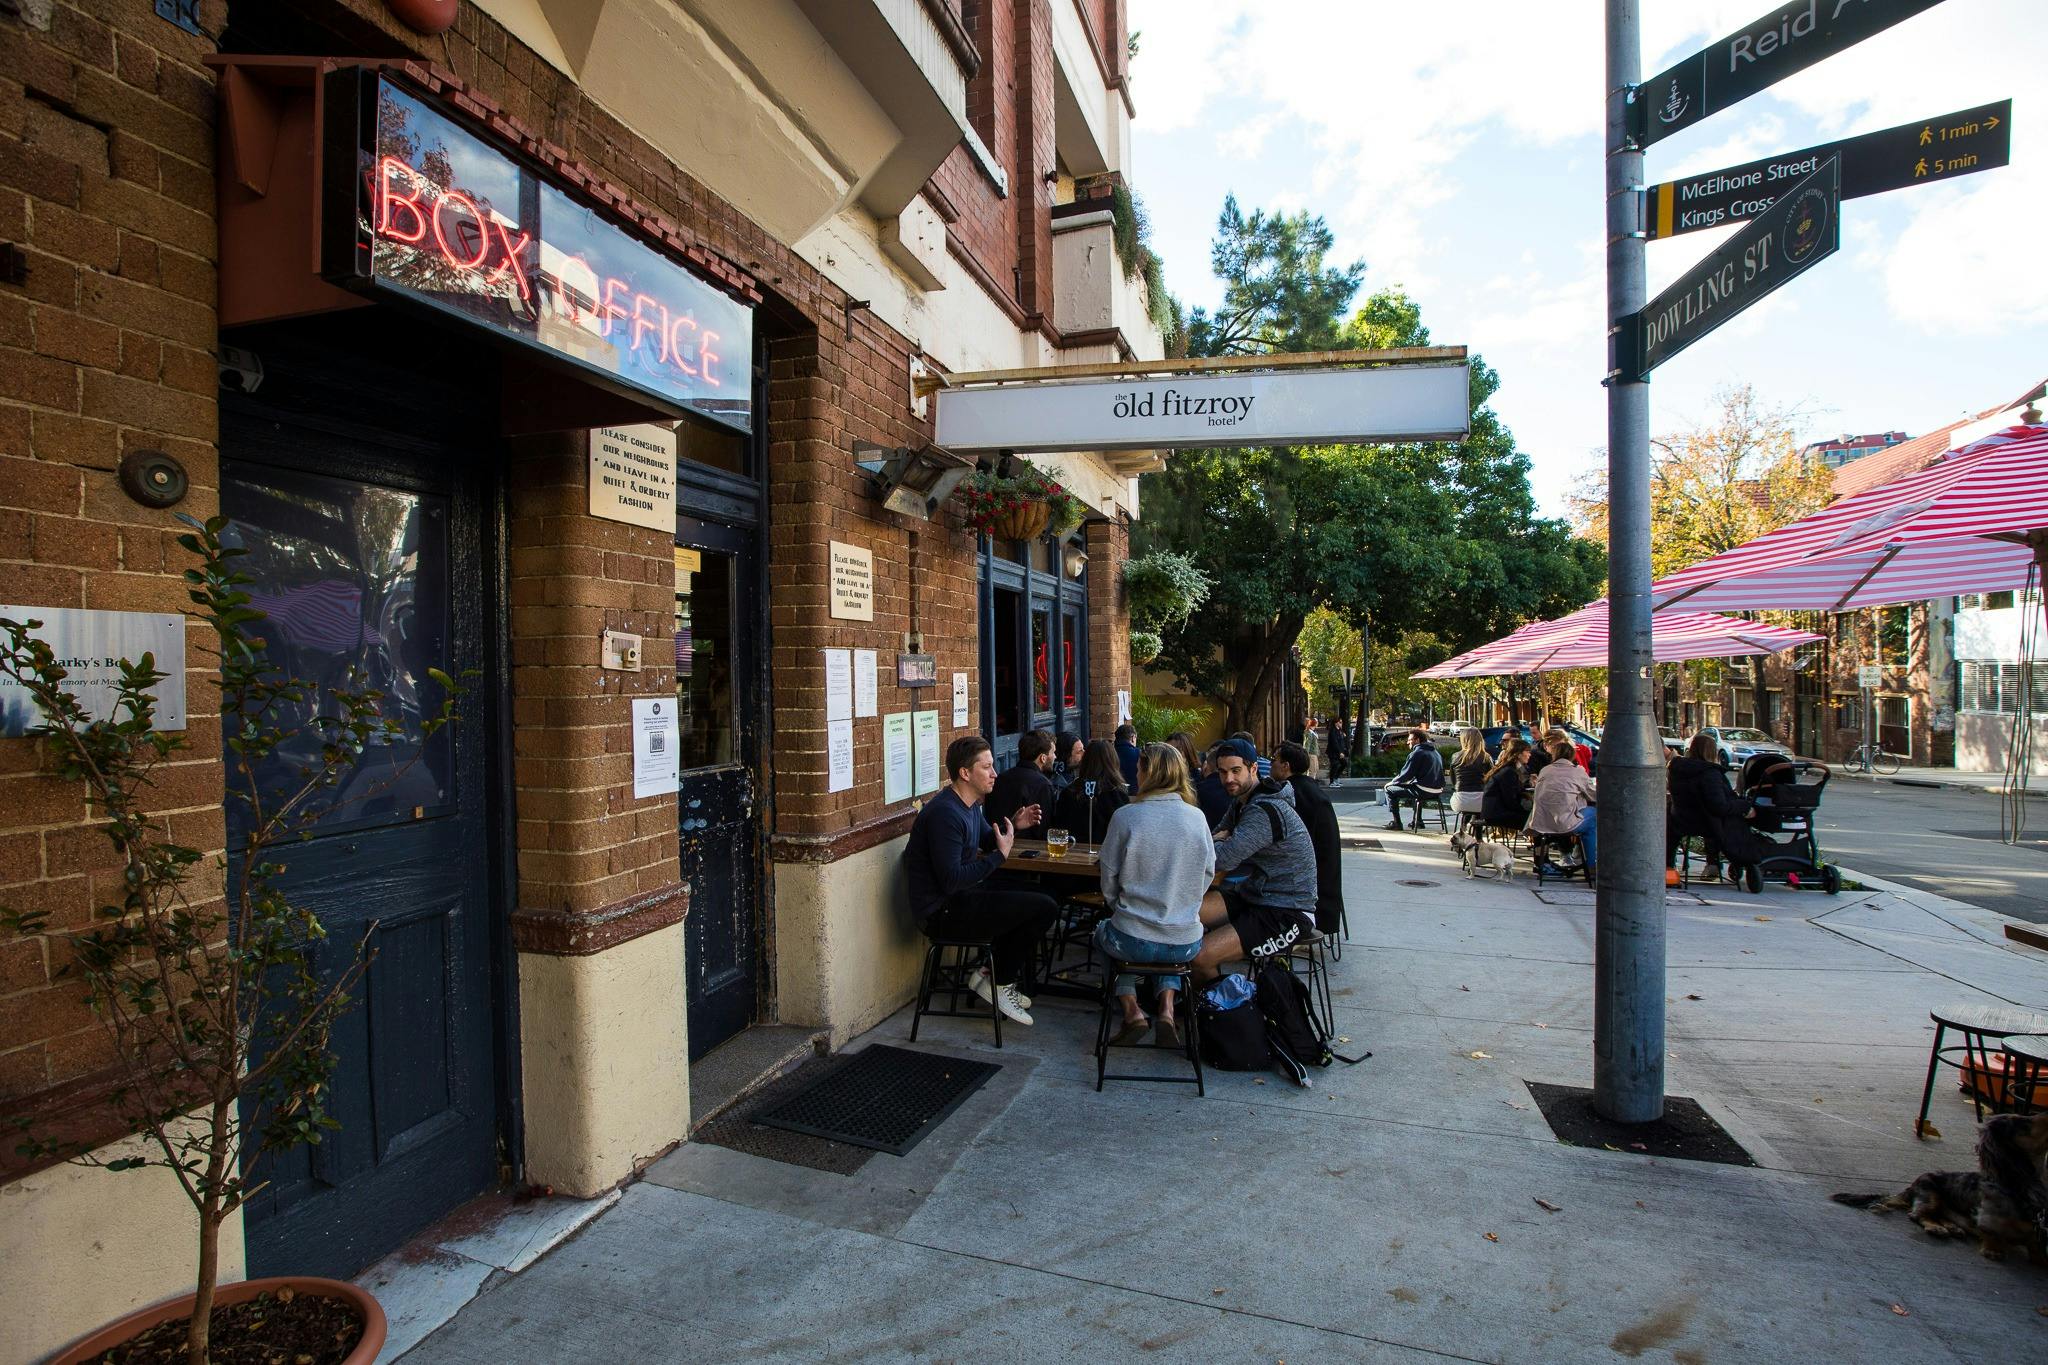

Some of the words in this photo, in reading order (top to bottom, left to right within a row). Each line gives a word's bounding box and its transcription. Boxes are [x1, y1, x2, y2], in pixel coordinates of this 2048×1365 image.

[1730, 0, 1816, 73] Reid
[1939, 127, 1946, 141] 1
[1949, 122, 1979, 139] min
[1934, 159, 1944, 174] 5
[1948, 153, 1977, 171] min
[1682, 171, 1762, 200] McElhone
[1767, 156, 1818, 181] Street
[1681, 207, 1725, 228] Kings
[377, 156, 529, 300] BOX
[559, 256, 720, 387] OFFICE
[1646, 262, 1735, 352] DOWLING
[1744, 232, 1772, 283] ST
[1113, 392, 1154, 418] old
[1162, 390, 1255, 421] fitzroy
[1208, 416, 1236, 427] hotel
[603, 444, 619, 456] OUR
[624, 451, 669, 470] NEIGHBOURS
[631, 437, 666, 454] CONSIDER
[603, 460, 621, 472] AND
[624, 466, 647, 480] LEAVE
[650, 474, 659, 483] IN
[603, 475, 625, 488] QUIET
[630, 480, 637, 492] &
[638, 485, 669, 500] ORDERLY
[618, 495, 653, 511] FASHION
[58, 679, 87, 688] emory
[1085, 781, 1096, 796] 87
[1251, 923, 1300, 957] adidas
